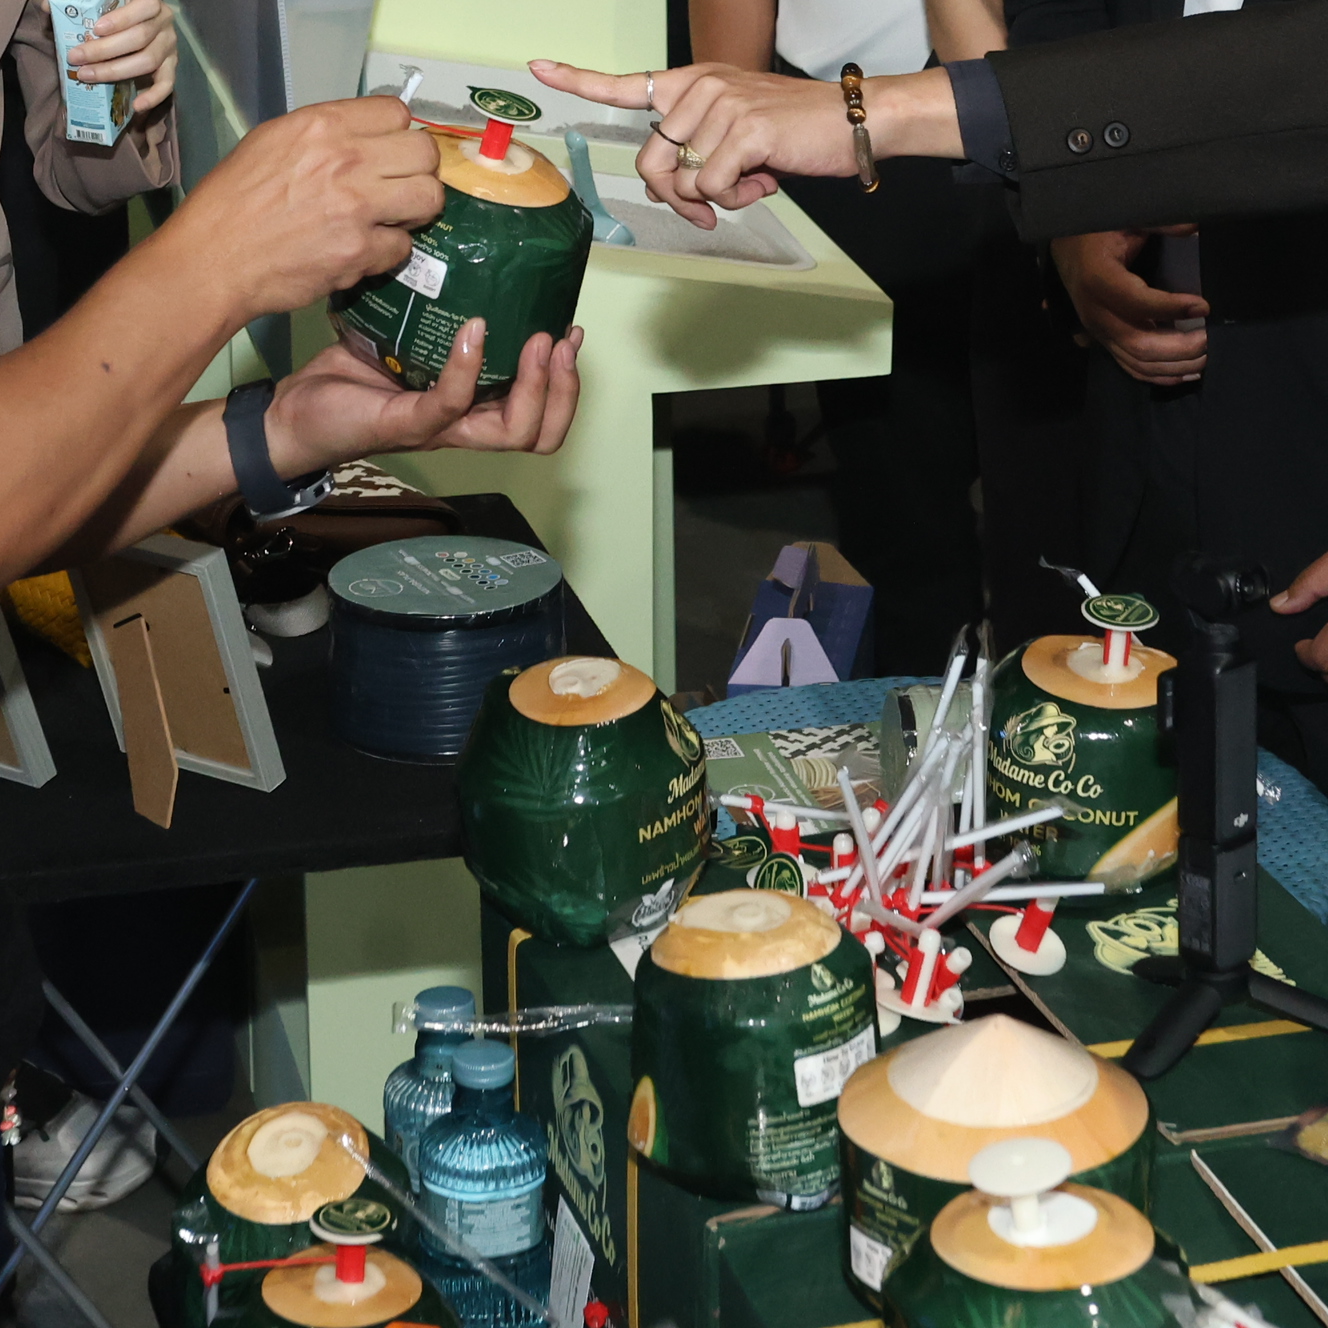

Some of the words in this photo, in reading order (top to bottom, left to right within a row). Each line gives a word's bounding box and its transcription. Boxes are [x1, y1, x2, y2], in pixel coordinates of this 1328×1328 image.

[1047, 769, 1074, 794] Co
[1077, 774, 1104, 799] Co
[587, 1189, 602, 1242] Co
[601, 1213, 616, 1267] Co
